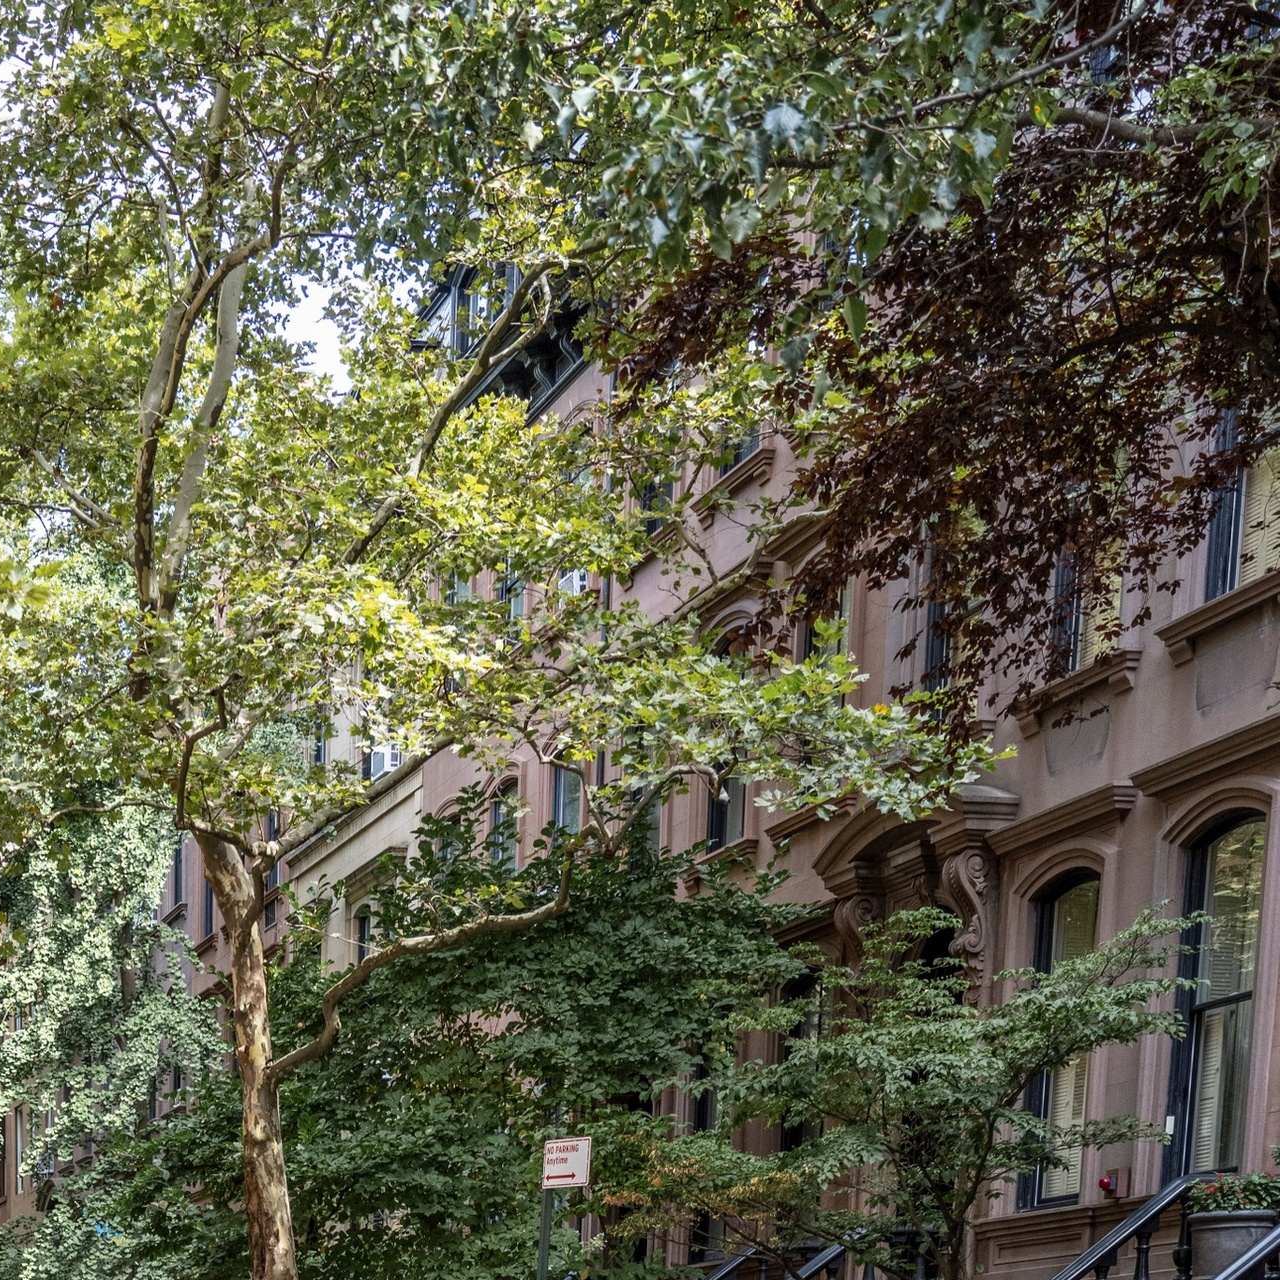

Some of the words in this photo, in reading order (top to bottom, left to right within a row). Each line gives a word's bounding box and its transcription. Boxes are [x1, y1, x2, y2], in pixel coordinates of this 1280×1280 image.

[547, 1147, 554, 1155] NO
[555, 1144, 579, 1154] PARKING
[547, 1156, 568, 1166] Anytime
